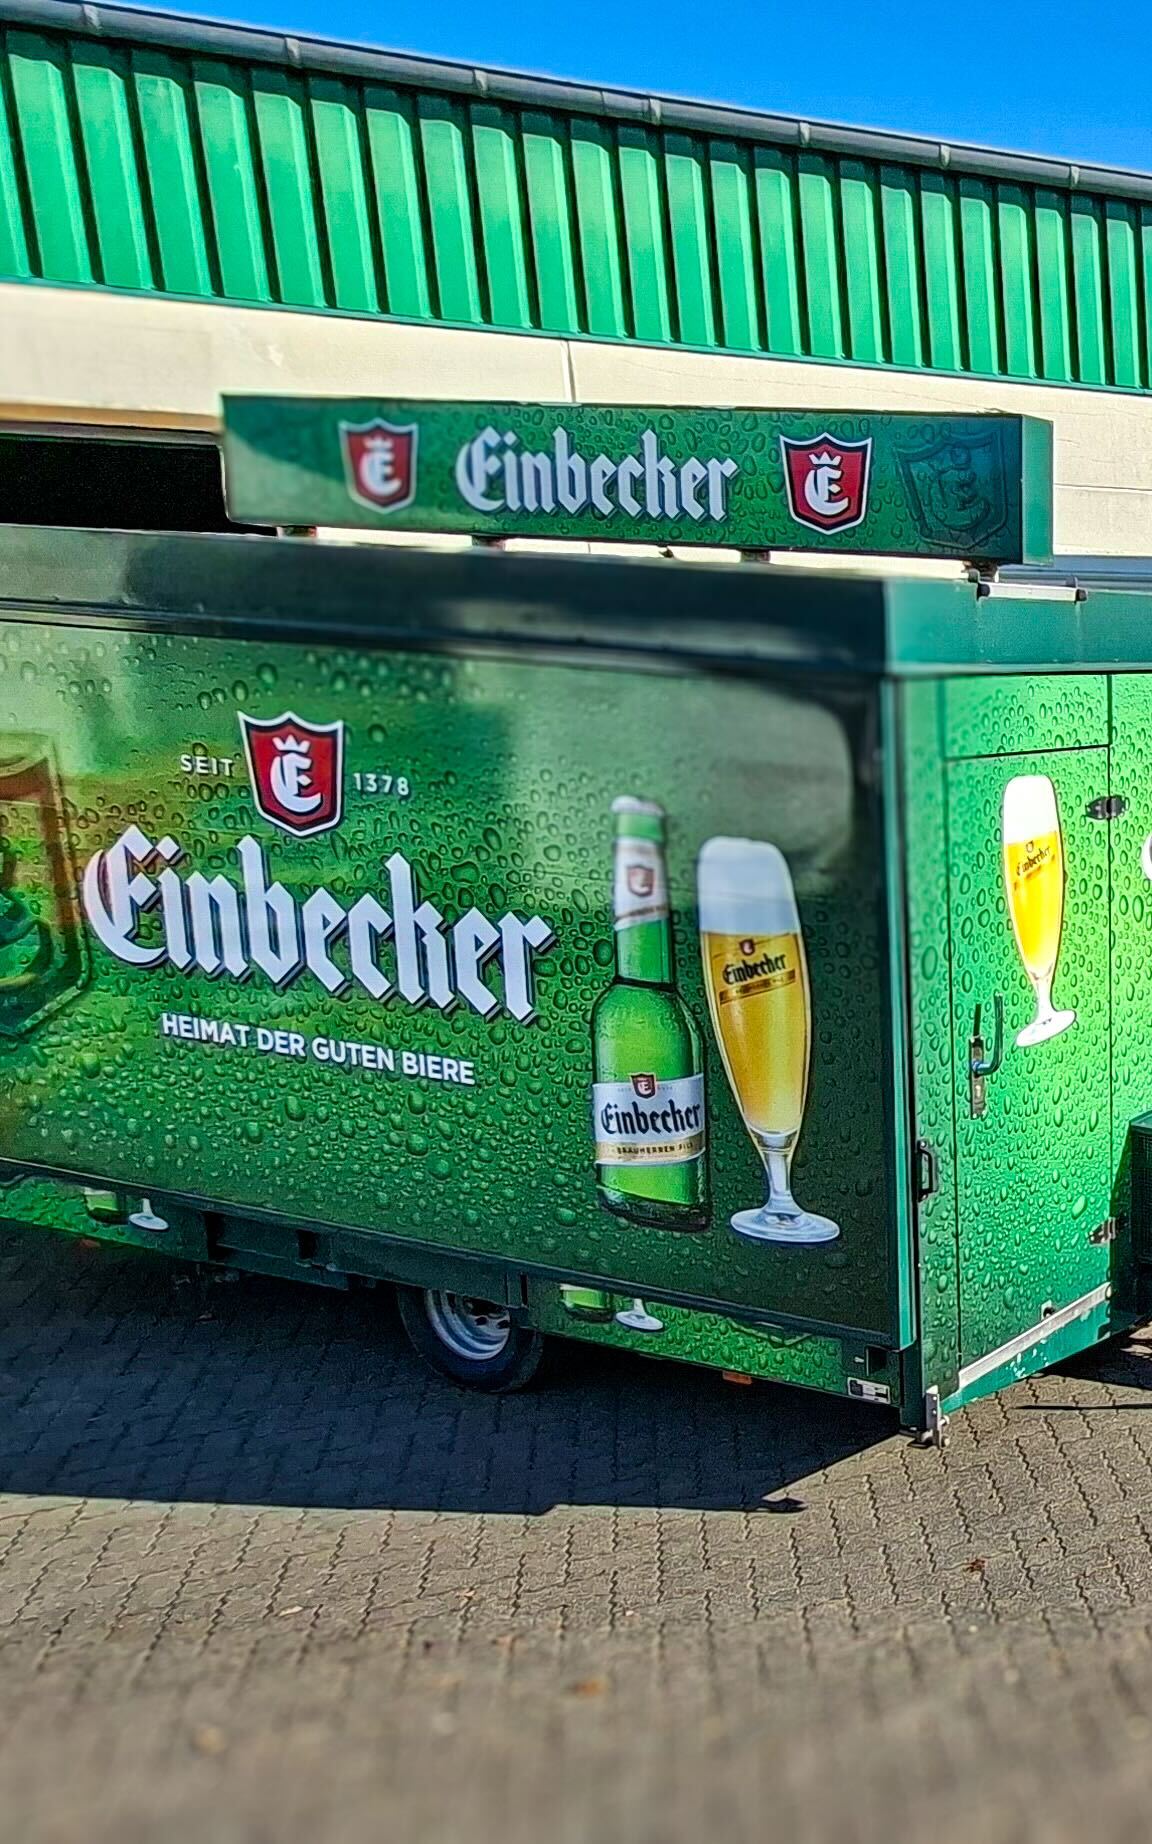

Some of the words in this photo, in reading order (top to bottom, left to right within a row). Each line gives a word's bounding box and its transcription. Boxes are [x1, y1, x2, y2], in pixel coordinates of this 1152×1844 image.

[456, 425, 738, 521] Einbecker
[180, 753, 235, 776] SEIT
[353, 772, 409, 796] 1378
[83, 824, 557, 1023] Einbecker
[722, 953, 787, 985] Einbecker
[161, 1012, 250, 1047] HEIMAT
[257, 1027, 306, 1056] DER
[312, 1037, 395, 1071] GUTEN
[401, 1051, 476, 1085] BIERE
[600, 1098, 701, 1134] Einbecker
